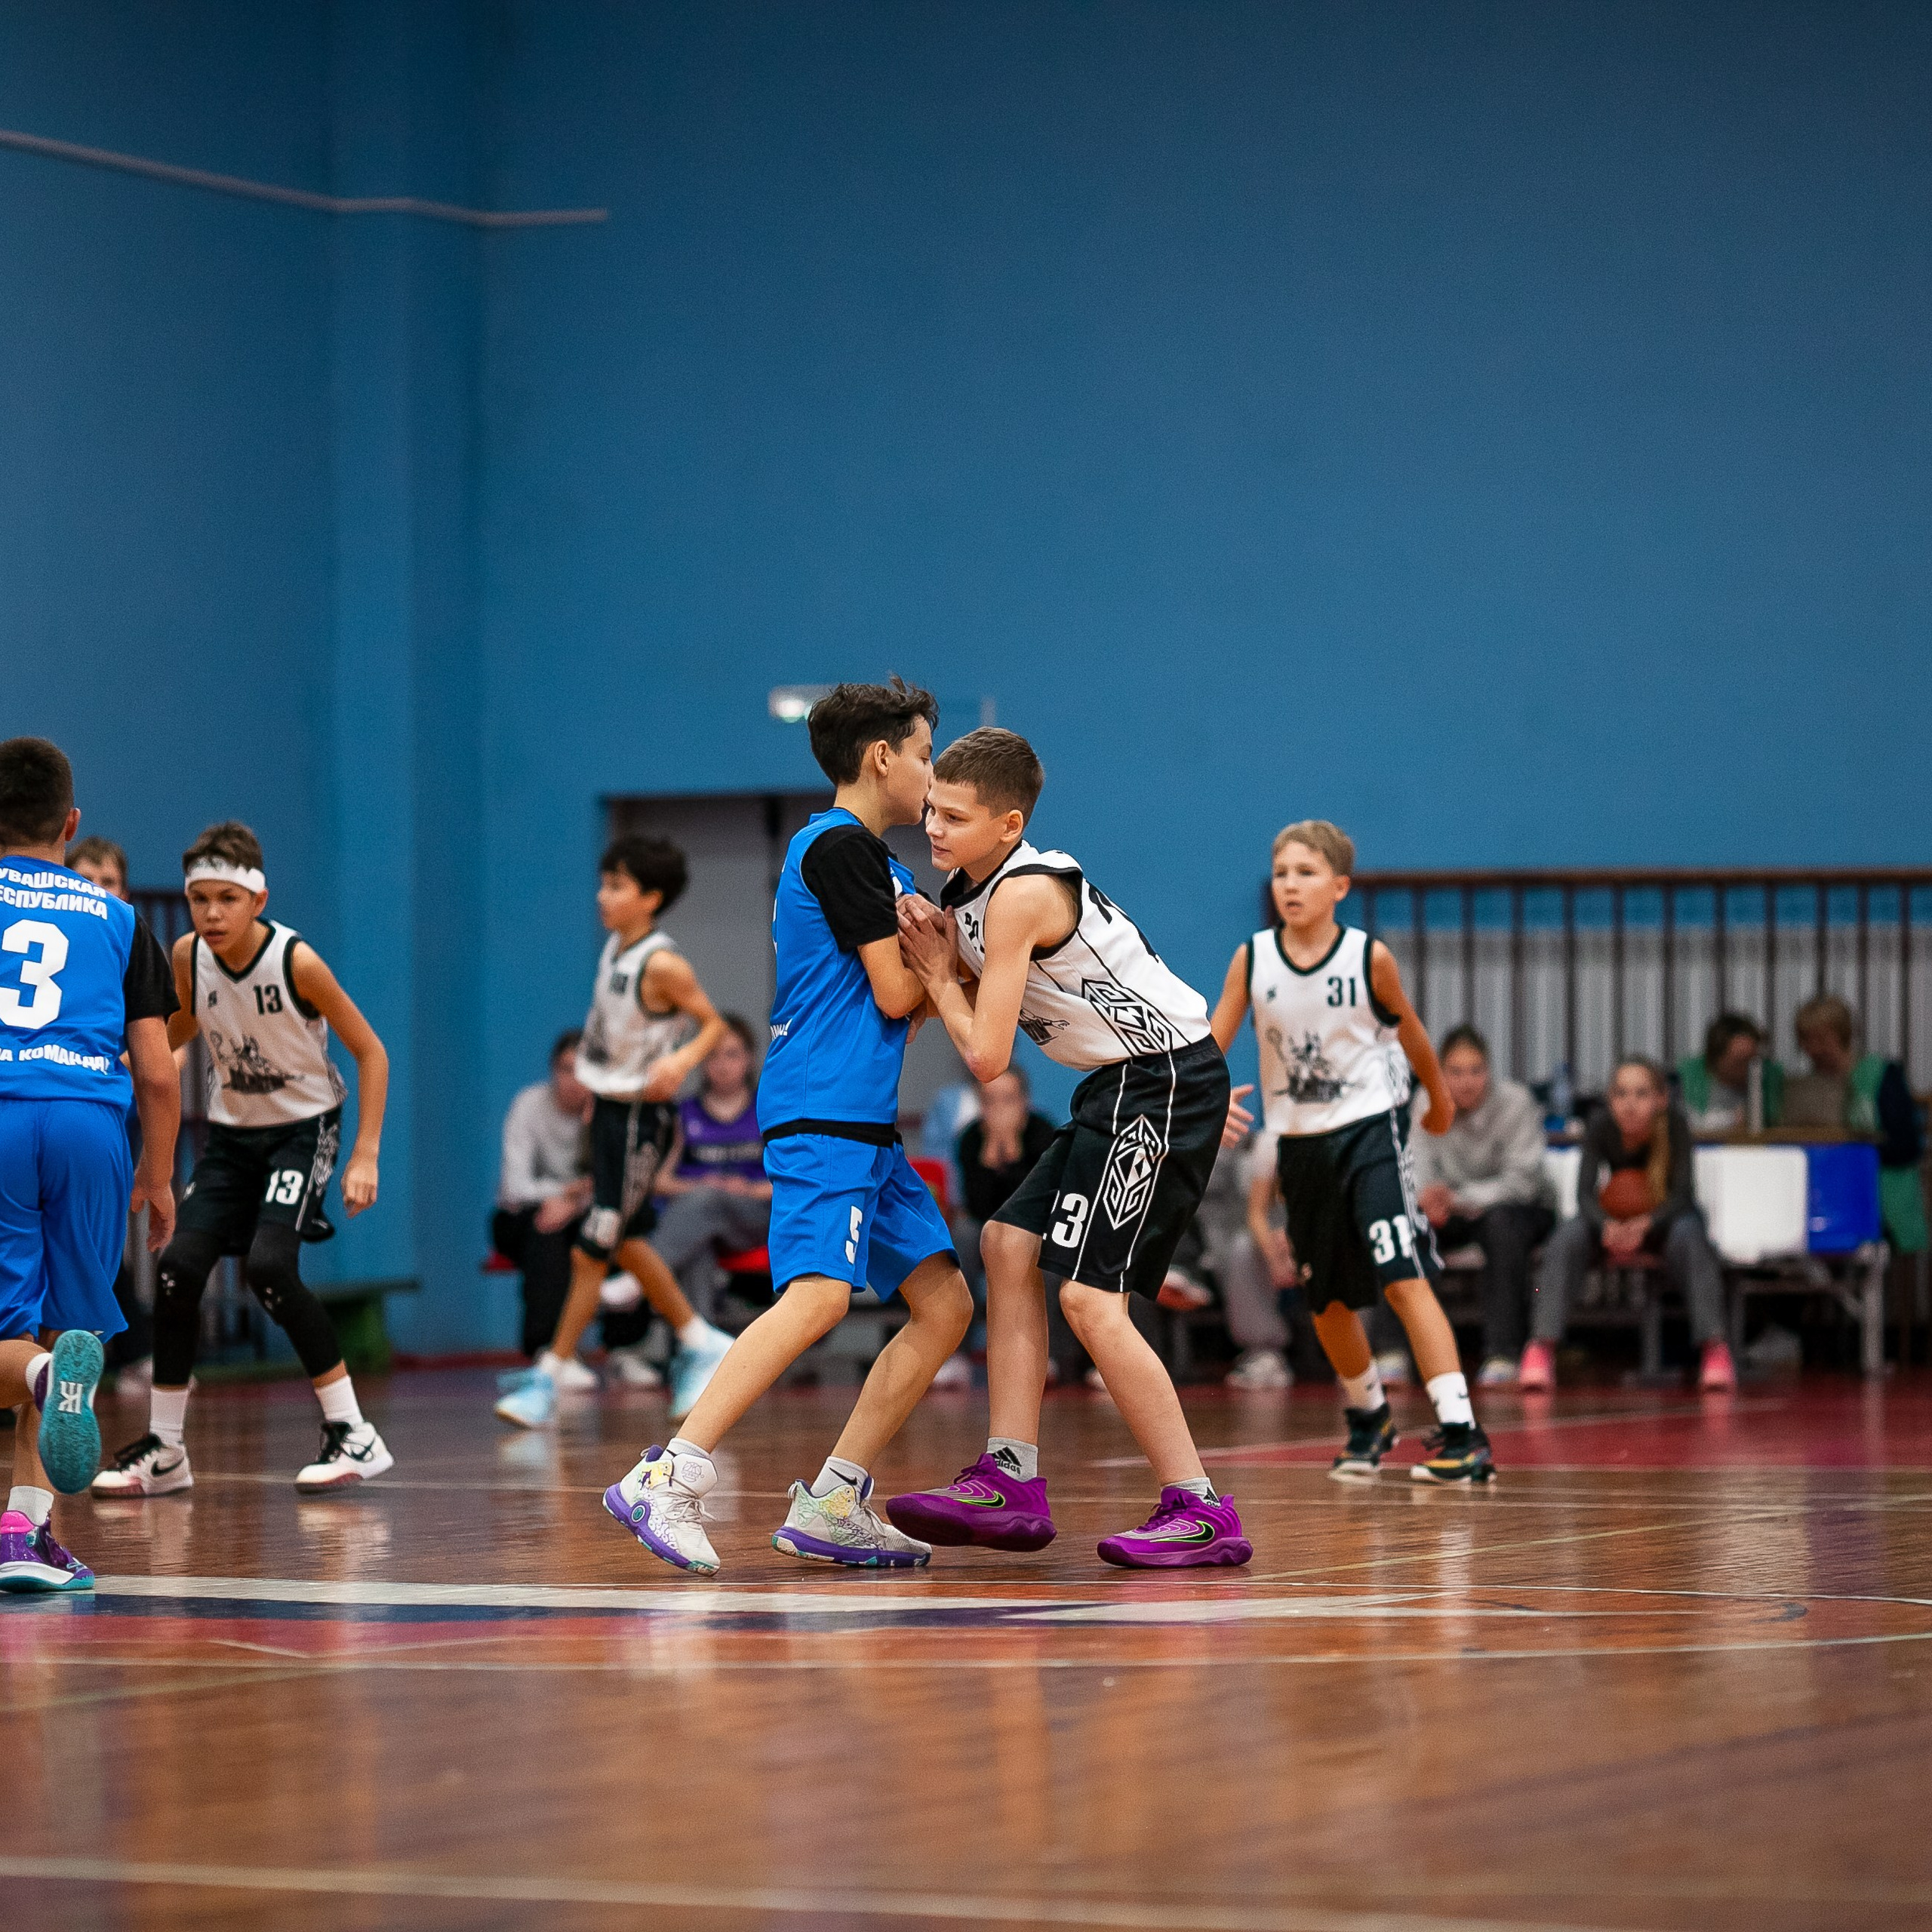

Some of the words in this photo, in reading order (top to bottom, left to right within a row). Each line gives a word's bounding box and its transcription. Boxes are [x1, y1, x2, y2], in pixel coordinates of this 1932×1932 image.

[0, 918, 69, 1029] 3
[254, 984, 283, 1015] 13
[1327, 976, 1356, 1008] 31
[265, 1169, 303, 1204] 13
[1043, 1193, 1088, 1248] 3
[1369, 1215, 1411, 1264] 31
[995, 1458, 1021, 1475] didas
